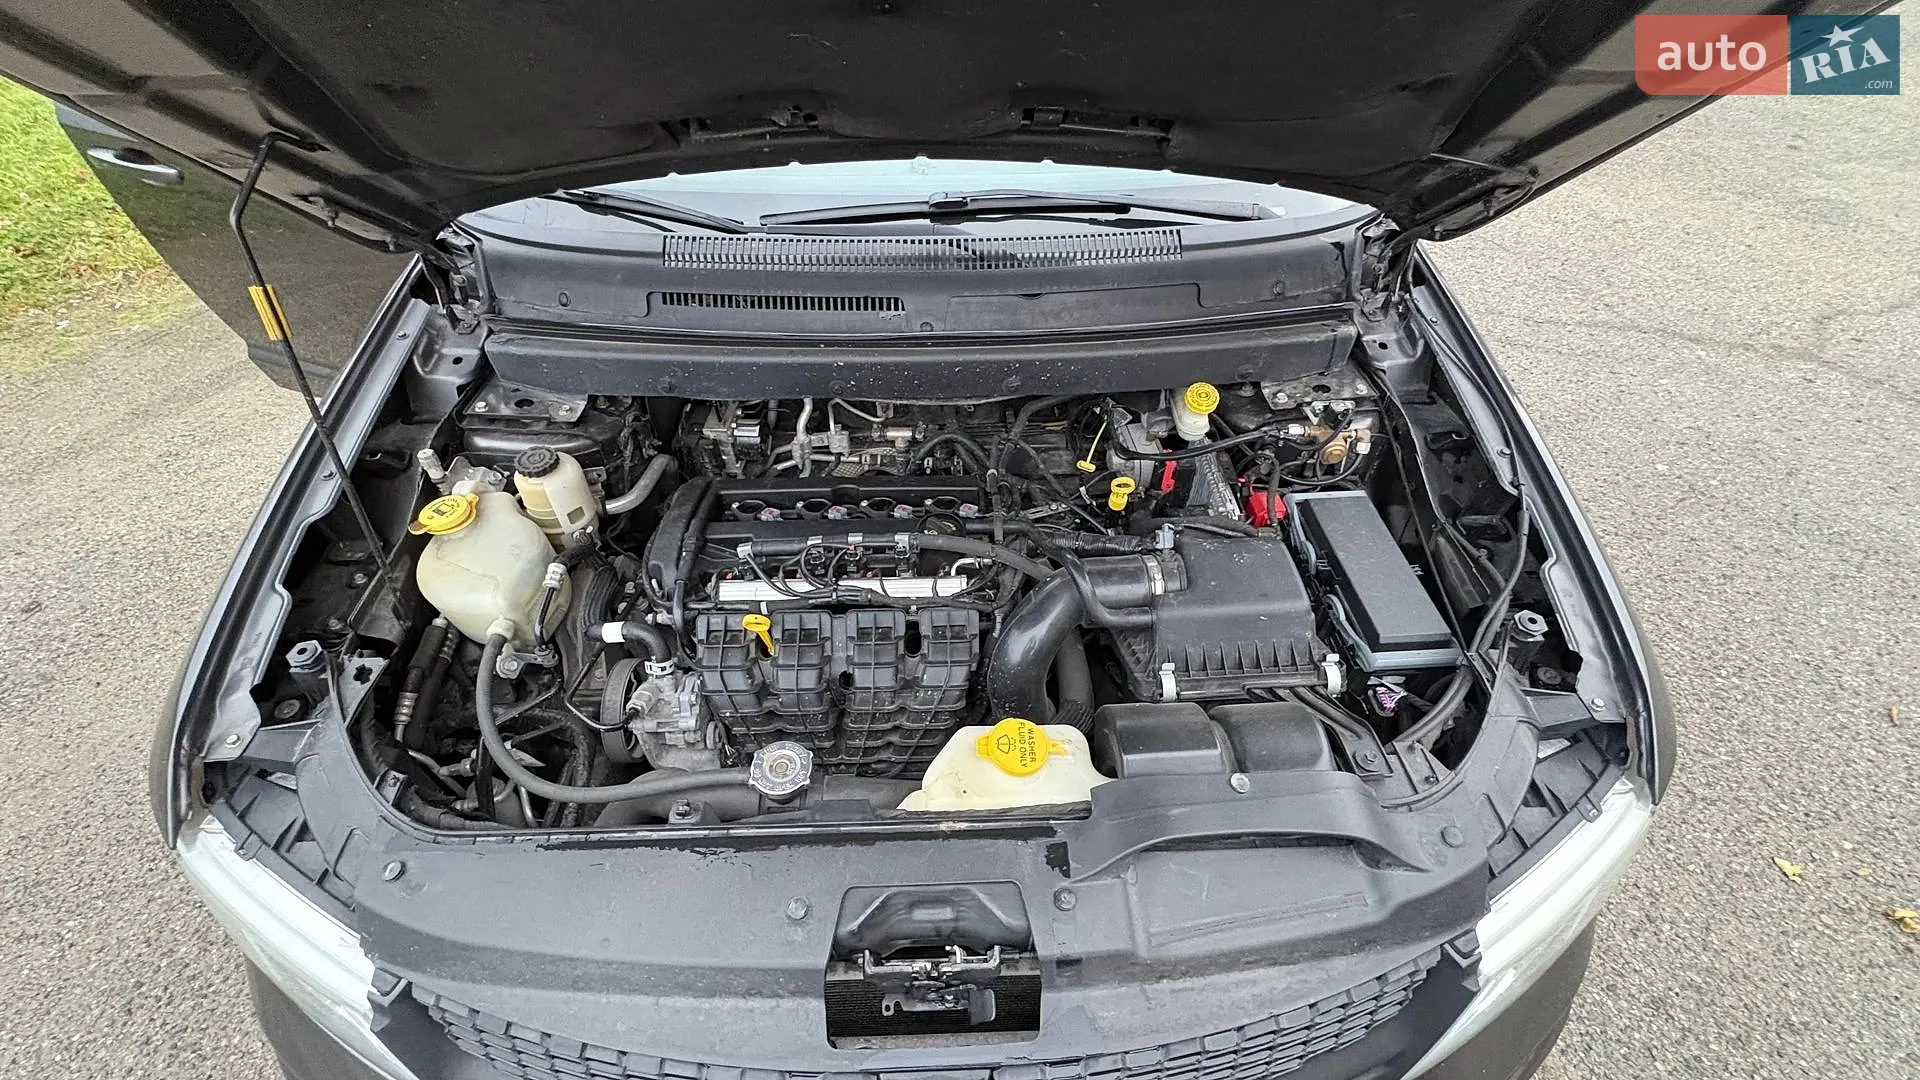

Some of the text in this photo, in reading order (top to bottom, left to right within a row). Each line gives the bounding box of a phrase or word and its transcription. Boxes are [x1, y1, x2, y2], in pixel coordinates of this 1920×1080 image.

[1018, 722, 1027, 767] FLUID ONLY
[1028, 728, 1036, 762] WASHER
